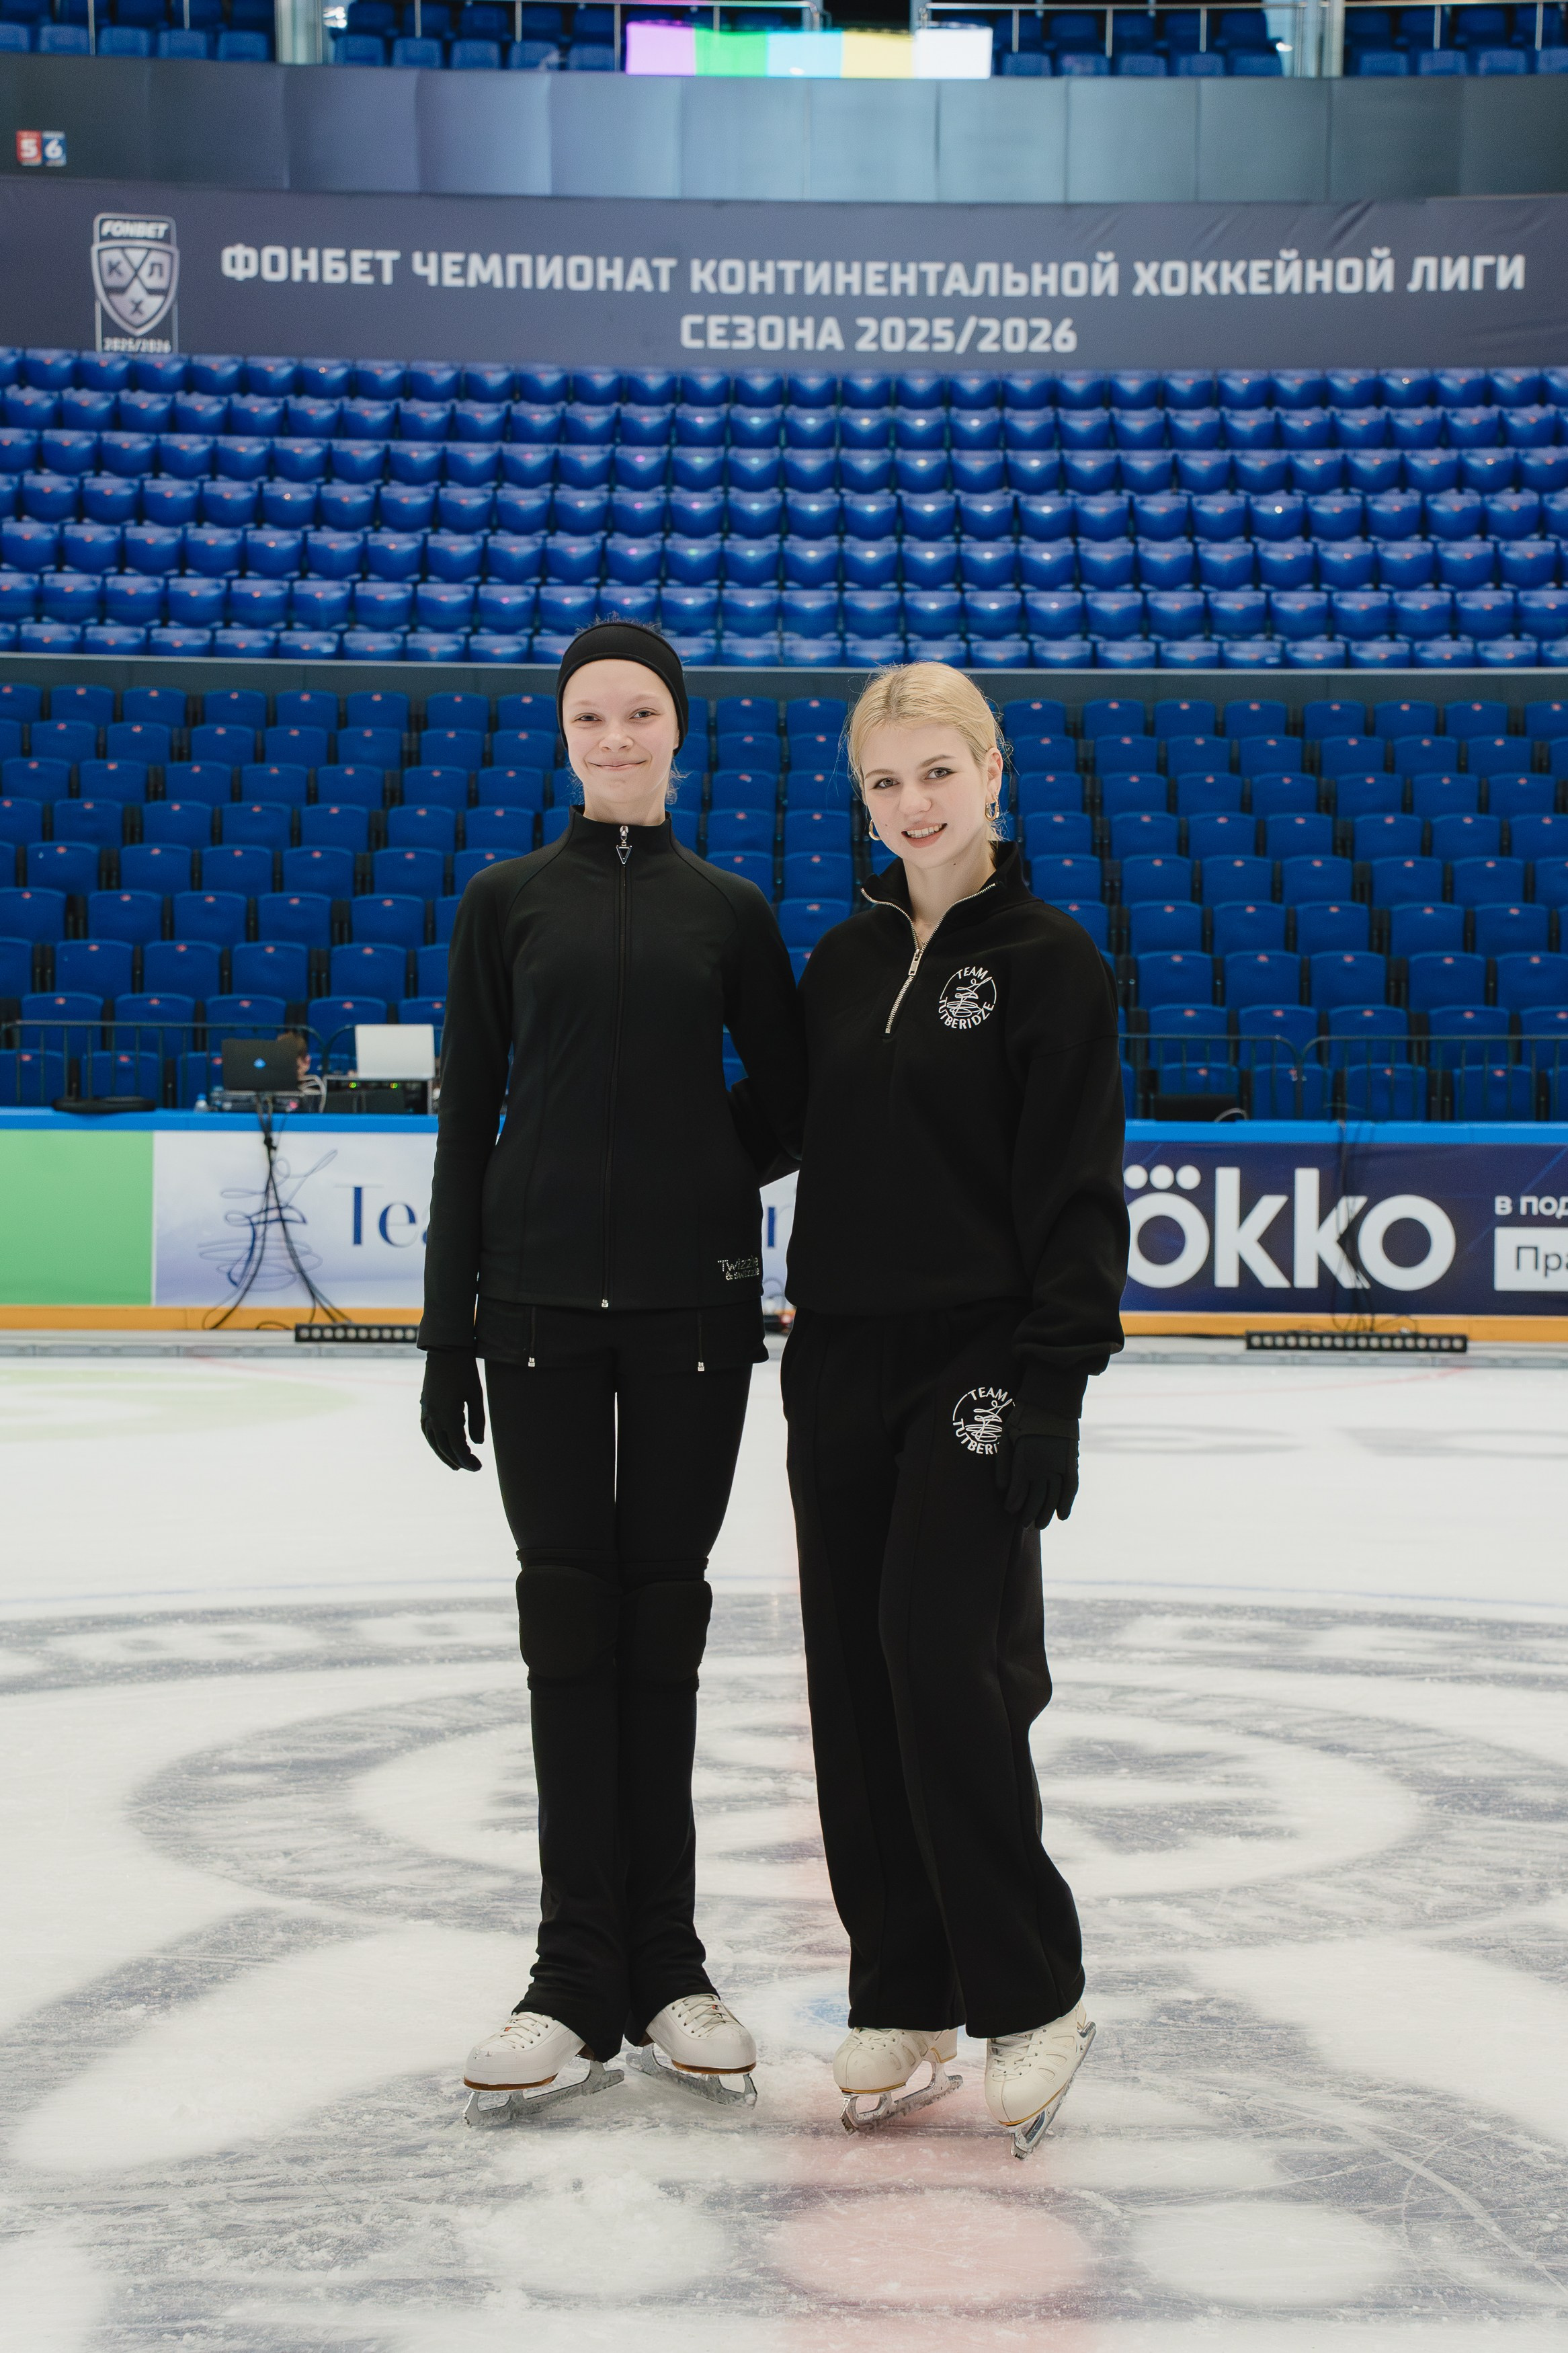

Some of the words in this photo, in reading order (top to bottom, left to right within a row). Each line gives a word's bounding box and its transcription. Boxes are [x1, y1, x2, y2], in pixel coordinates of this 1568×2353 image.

[21, 138, 38, 158] 5
[45, 139, 63, 159] 6
[101, 220, 169, 239] FONBET
[108, 260, 123, 278] К
[222, 243, 401, 284] ФОНБЕТ
[412, 251, 677, 292] ЧЕМПИОНАТ
[691, 250, 1118, 297] КОНТИНЕНТАЛЬНОЙ
[1132, 247, 1395, 296] ХОККЕЙНОЙ
[1407, 253, 1526, 292] ЛИГИ
[680, 315, 845, 351] СЕЗОНА
[856, 316, 1077, 354] 2025/2026
[956, 966, 989, 980] TEAM
[938, 996, 995, 1029] TUTBERIDZE
[334, 1184, 430, 1248] Te
[1516, 1246, 1568, 1278] Пр
[968, 1387, 1008, 1402] TEAM
[952, 1418, 1000, 1455] TUTBERI
